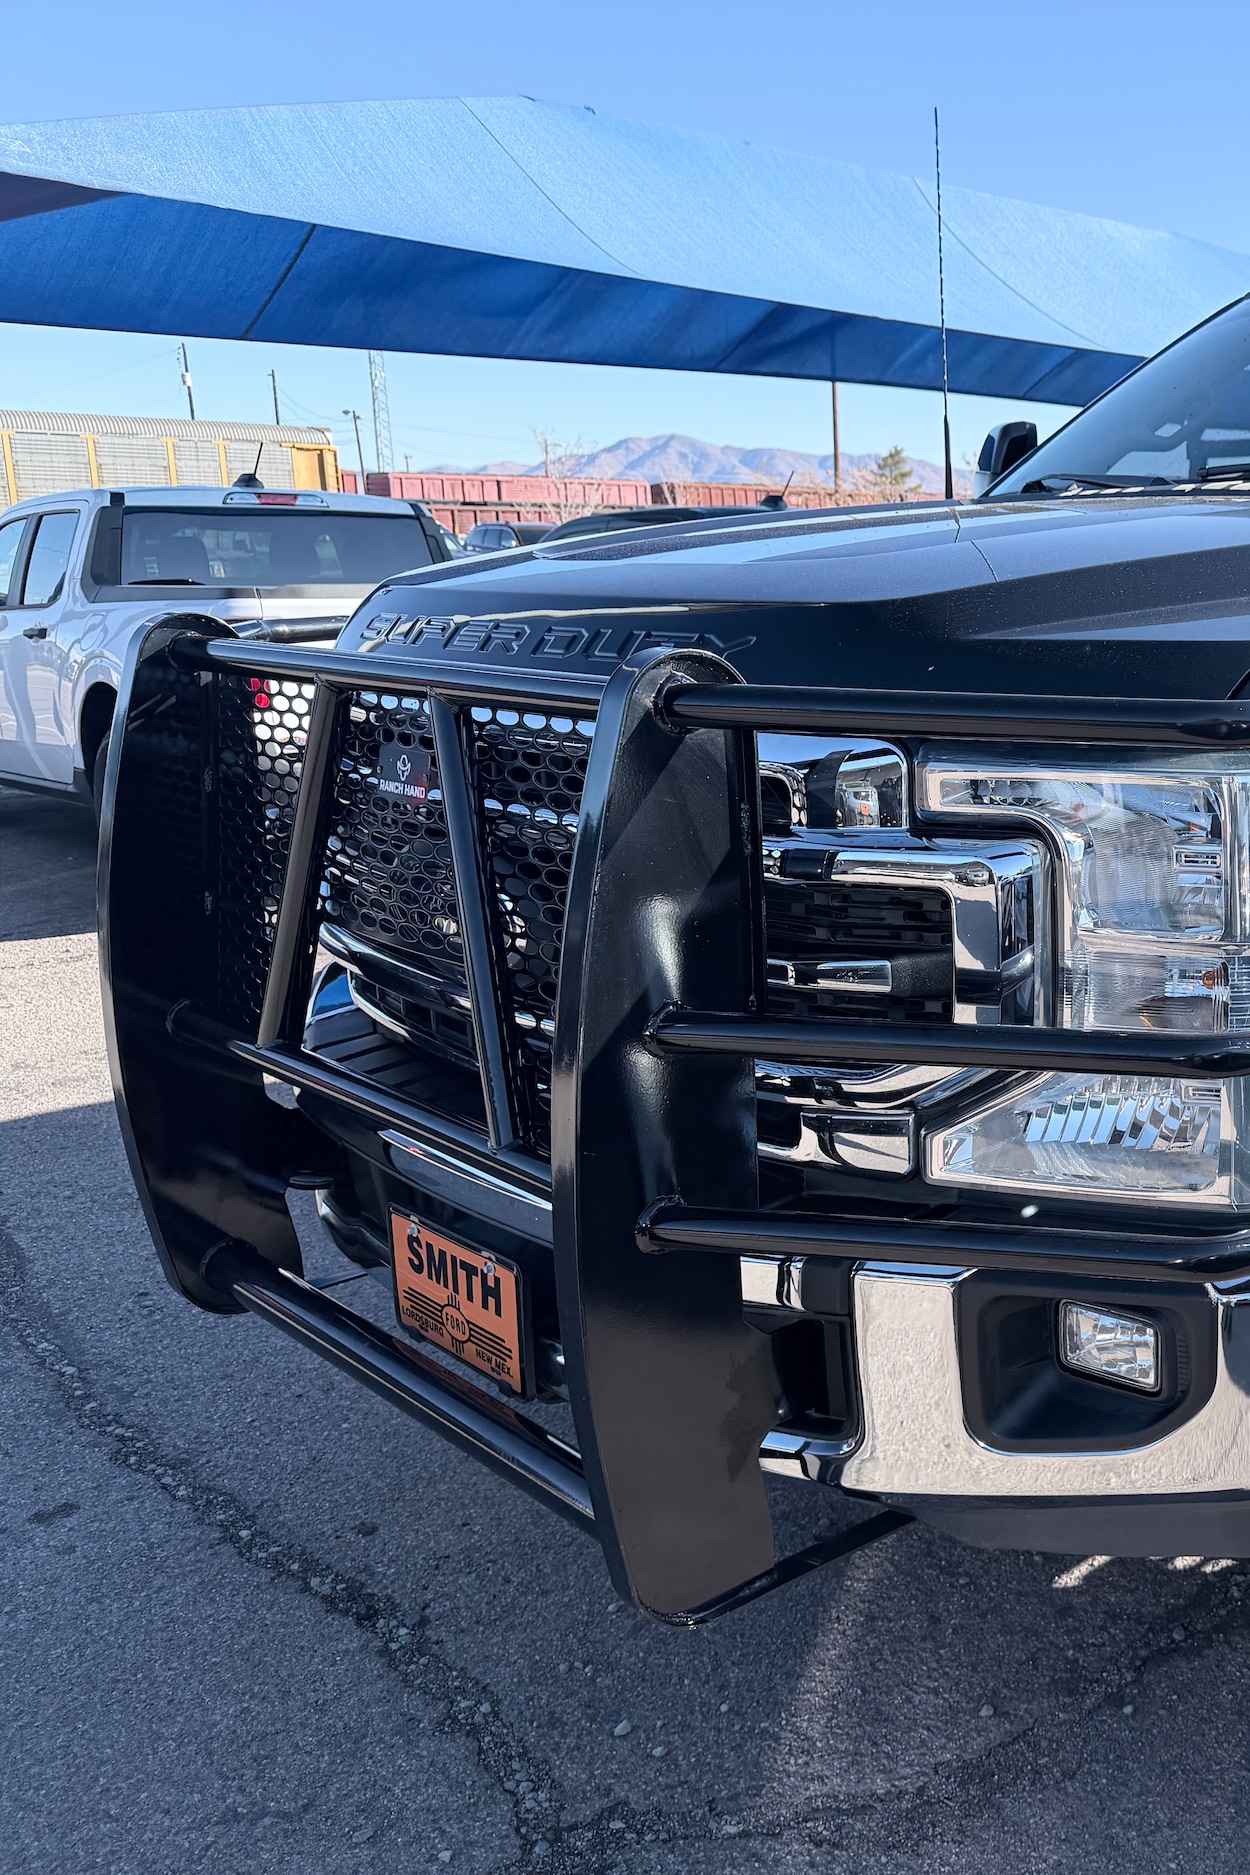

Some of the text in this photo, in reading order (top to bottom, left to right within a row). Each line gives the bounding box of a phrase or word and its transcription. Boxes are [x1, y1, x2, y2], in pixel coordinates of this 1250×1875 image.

[361, 613, 757, 662] SUPER DUTY
[379, 779, 426, 799] RANCH HAND
[407, 1230, 503, 1319] SMITH
[402, 1304, 514, 1379] LORDSBURG NEW MEX.
[445, 1313, 466, 1336] FORD
